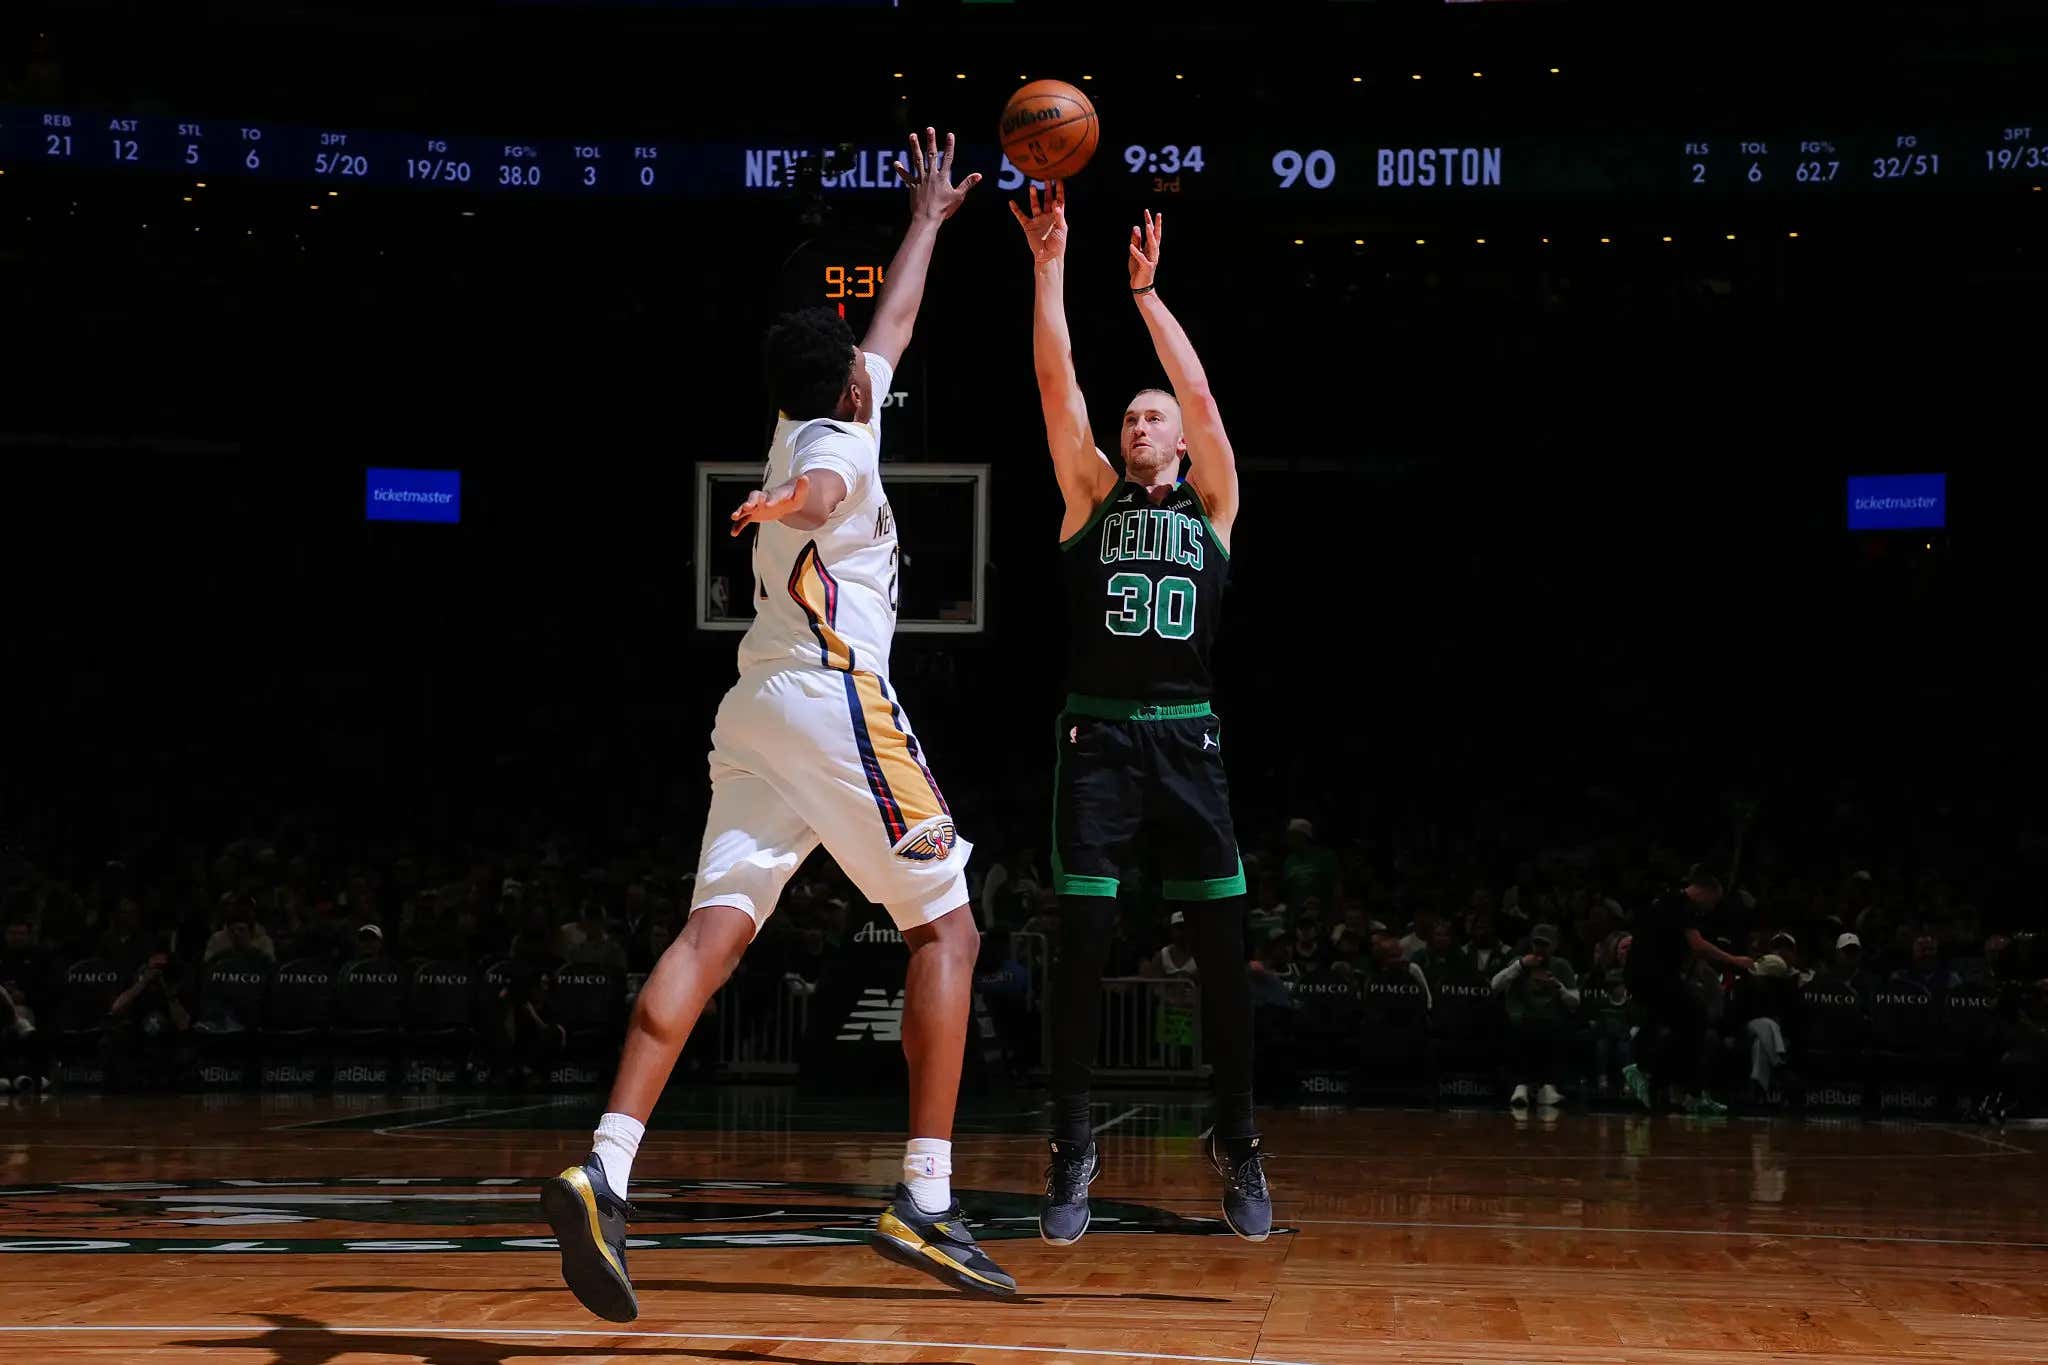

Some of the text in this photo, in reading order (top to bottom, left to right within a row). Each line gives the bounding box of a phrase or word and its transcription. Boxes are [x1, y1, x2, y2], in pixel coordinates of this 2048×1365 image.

[42, 113, 71, 127] REB
[109, 119, 138, 132] AST
[178, 124, 203, 137] STL
[240, 128, 262, 141] TO
[2003, 127, 2031, 141] 3PT
[47, 134, 72, 156] 21
[320, 133, 347, 147] 3PT
[427, 140, 447, 153] FG
[1896, 136, 1918, 149] FG
[112, 140, 140, 160] 12
[185, 144, 199, 165] 5
[504, 146, 537, 158] FG%
[574, 146, 601, 158] TOL
[635, 147, 657, 158] FLS
[1685, 142, 1710, 155] FLS
[1739, 142, 1768, 155] TOL
[1801, 141, 1837, 154] FG%
[245, 149, 260, 169] 6
[314, 154, 368, 176] 5/20
[1123, 144, 1205, 174] 9:34
[406, 159, 472, 182] 19/50
[819, 149, 951, 188] ORLEA
[1271, 149, 1336, 190] 90
[1376, 147, 1502, 187] BOSTON
[1691, 163, 1706, 184] 2
[1747, 161, 1762, 183] 6
[1796, 161, 1840, 183] 62.7
[1871, 154, 1940, 179] 32/51
[498, 165, 541, 185] 38.0
[584, 166, 596, 185] 3
[640, 166, 654, 185] 0
[1151, 176, 1181, 193] 3rd
[373, 488, 453, 504] ticketmaster
[1855, 496, 1937, 511] ticketmaster
[1099, 508, 1204, 572] CELTICS
[1104, 572, 1197, 640] 30
[853, 920, 904, 944] Ami
[66, 971, 118, 984] PIMCO
[210, 972, 262, 984] PIMCO
[279, 973, 328, 984] PIMCO
[350, 973, 400, 984] PIMCO
[418, 975, 467, 984] PIMCO
[557, 975, 608, 984] PIMCO
[1369, 983, 1420, 994] PIMCO
[1441, 983, 1491, 997] PIMCO
[1803, 991, 1856, 1006] PIMCO
[1875, 992, 1929, 1006] PIMCO
[1950, 995, 1991, 1008] PIMC
